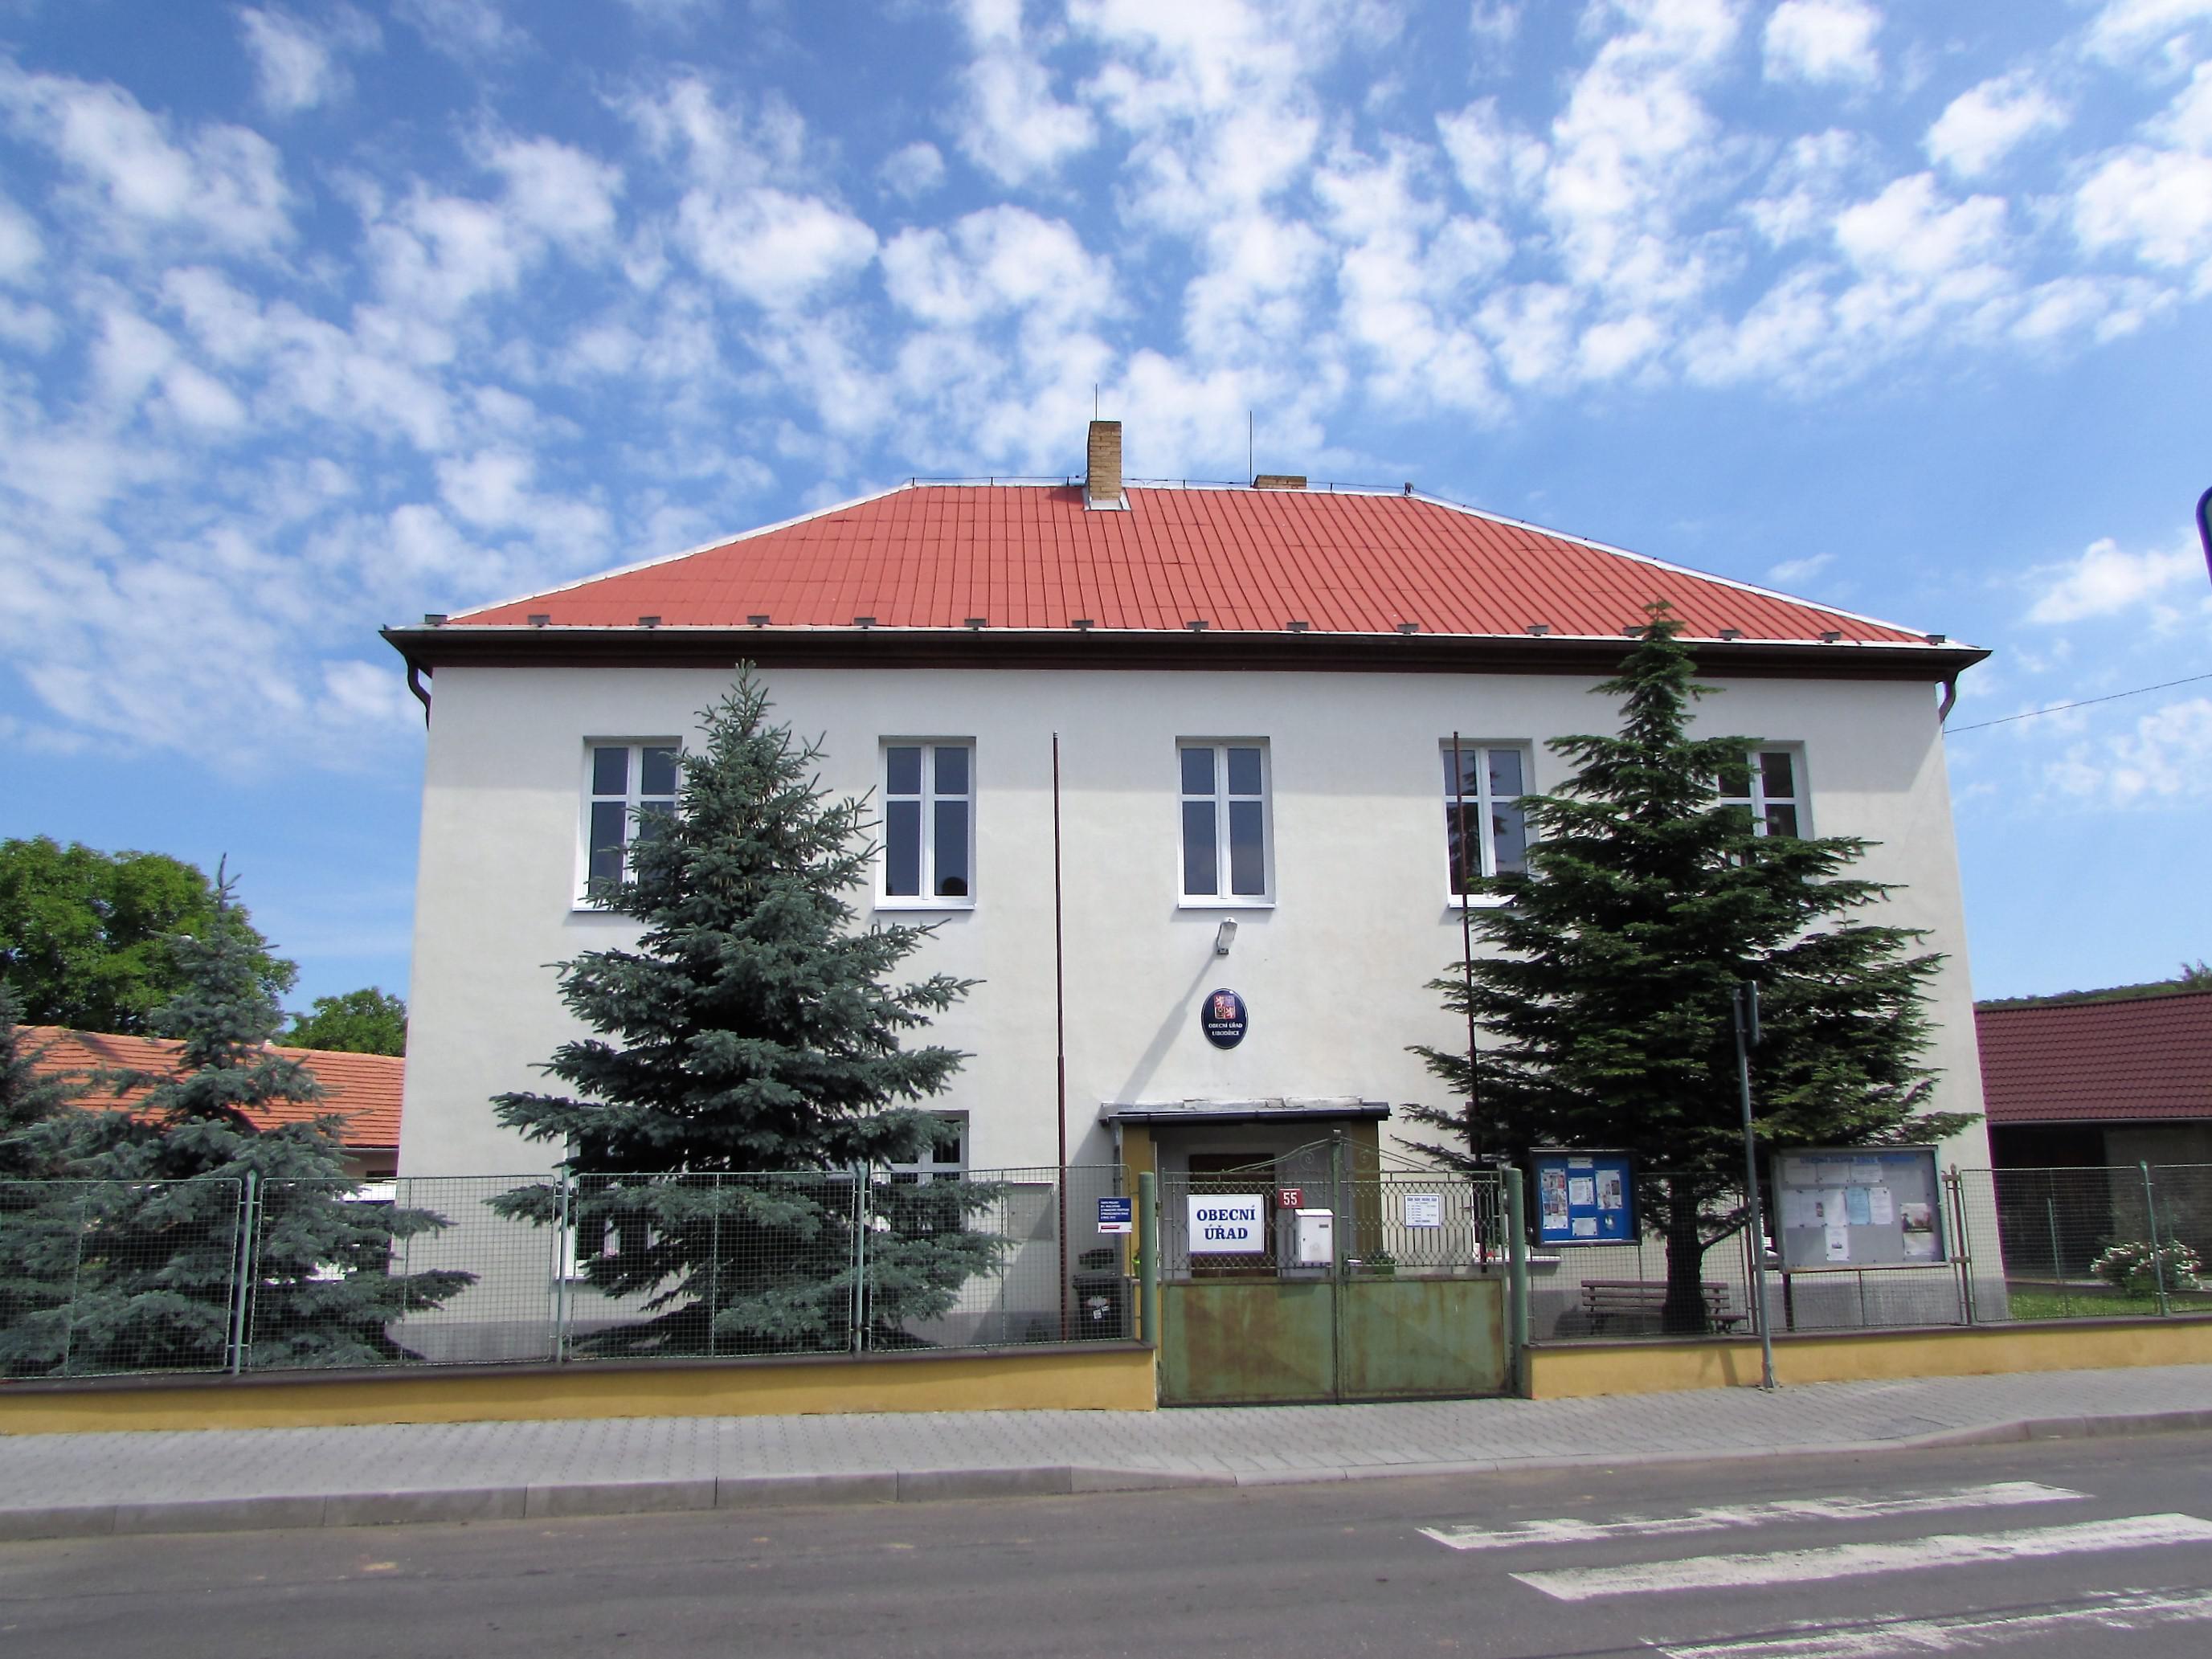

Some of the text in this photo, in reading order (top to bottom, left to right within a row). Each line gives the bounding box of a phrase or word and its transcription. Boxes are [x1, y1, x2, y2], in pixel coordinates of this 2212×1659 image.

[1283, 1192, 1298, 1205] 55
[1196, 1204, 1255, 1221] OBECNÍ
[1204, 1224, 1248, 1240] ÚŘAD
